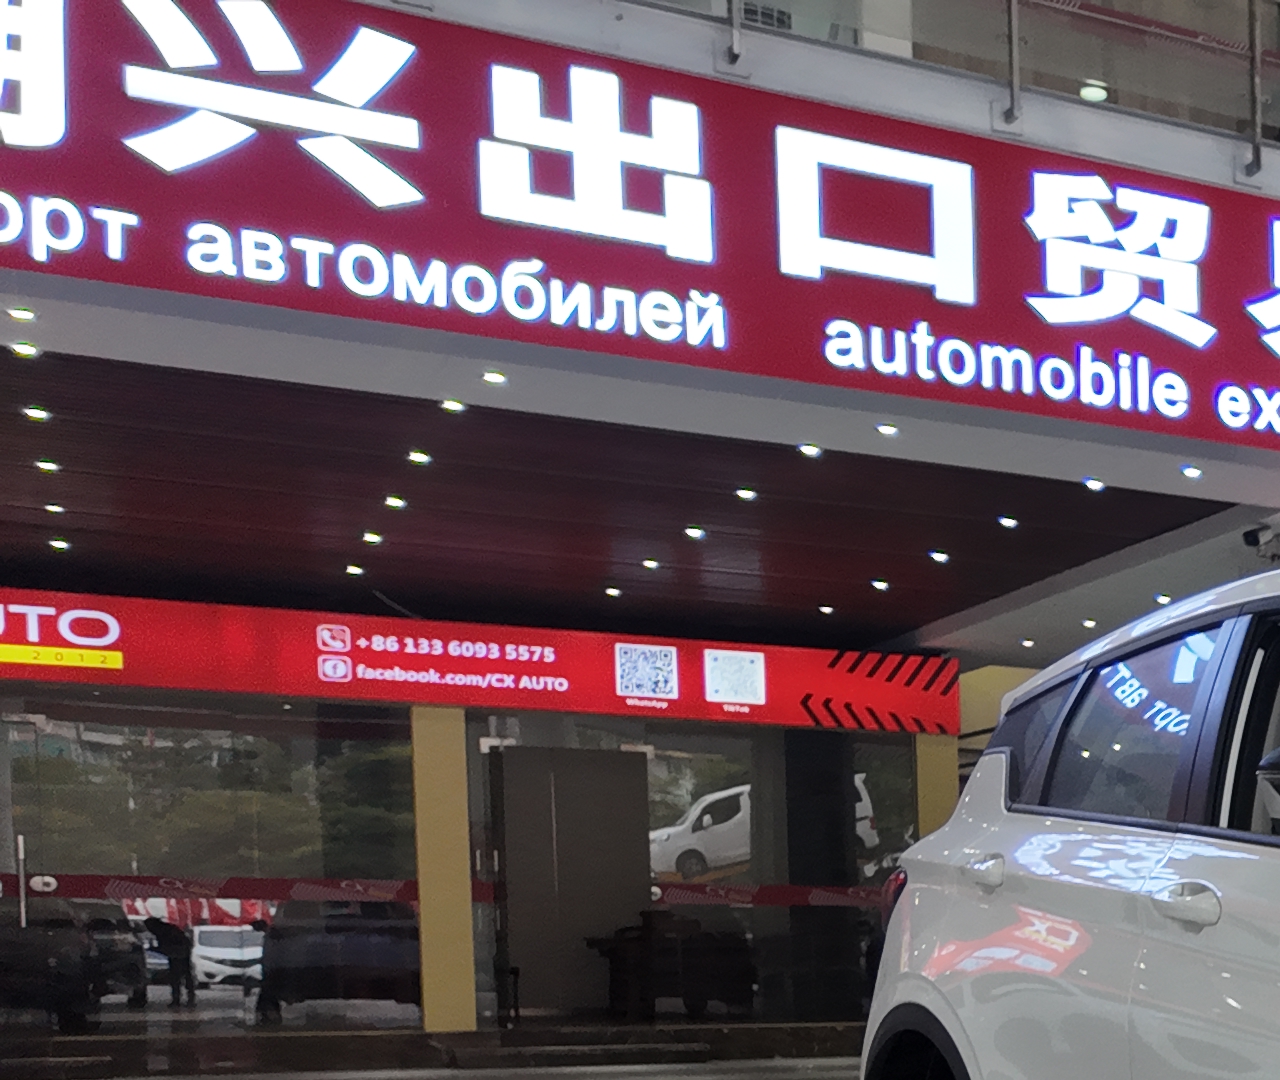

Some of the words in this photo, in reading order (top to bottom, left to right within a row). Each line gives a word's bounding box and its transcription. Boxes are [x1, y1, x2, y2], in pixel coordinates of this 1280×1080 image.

[186, 220, 729, 349] автомобилей
[822, 317, 1190, 418] automobile
[0, 604, 121, 646] TO
[32, 650, 108, 665] 2012
[356, 634, 400, 652] +86
[403, 637, 444, 655] 133
[447, 640, 500, 659] 6093
[505, 644, 555, 663] 5575
[356, 663, 515, 688] facebook.com/CX
[518, 675, 569, 692] AUTO
